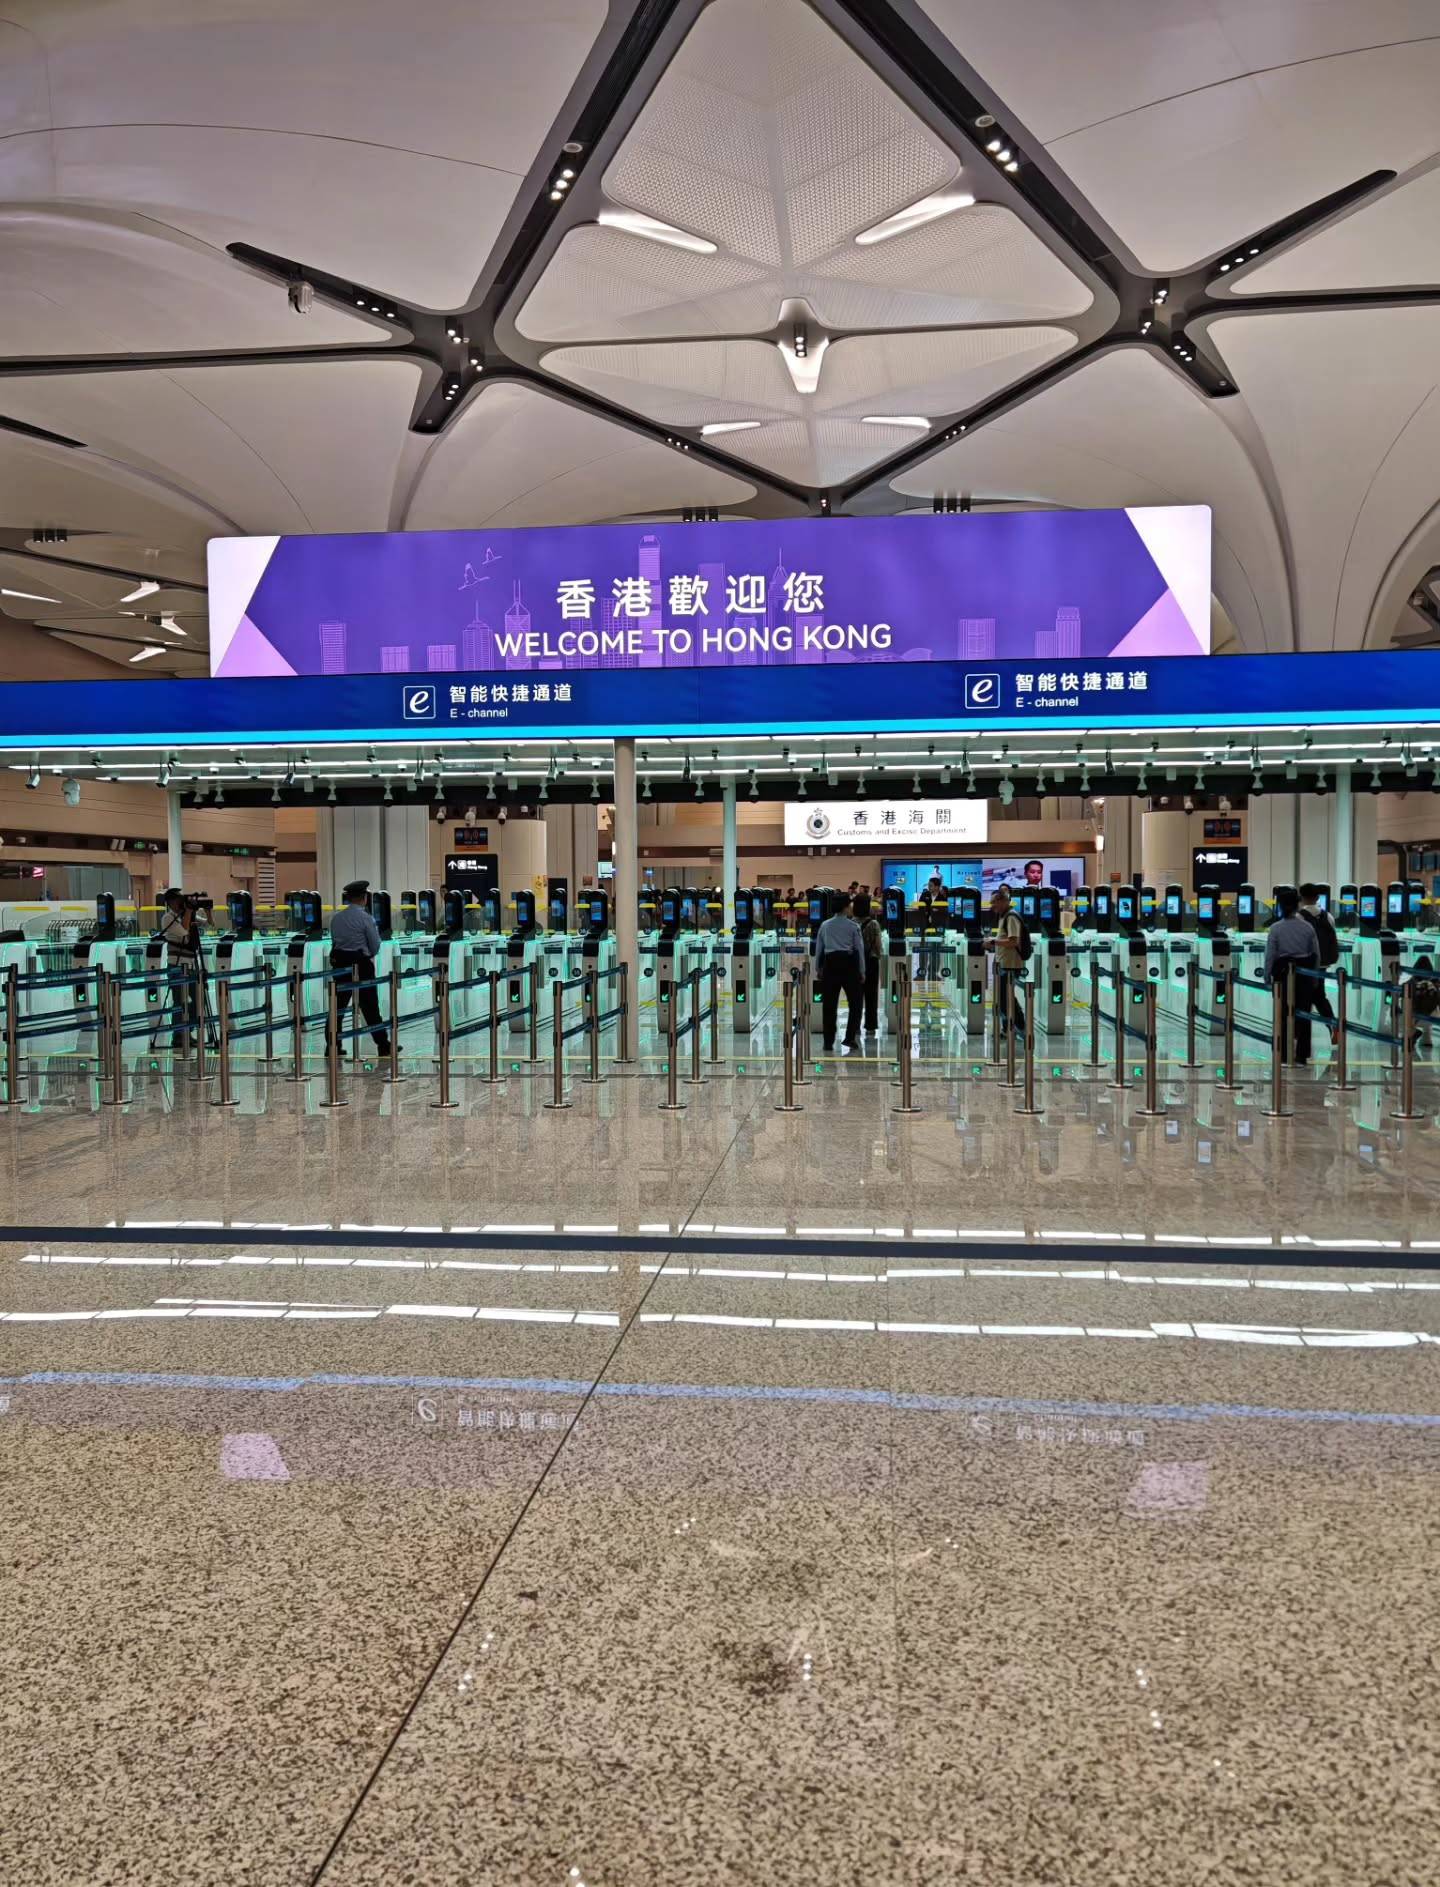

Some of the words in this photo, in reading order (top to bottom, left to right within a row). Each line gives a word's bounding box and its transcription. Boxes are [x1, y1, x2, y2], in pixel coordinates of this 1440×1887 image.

[556, 571, 825, 619] 香港歡迎您
[495, 629, 643, 657] WELCOME
[652, 628, 693, 654] TO
[702, 625, 793, 653] HONG
[803, 623, 892, 650] KONG
[1015, 671, 1148, 692] 智能快捷通道
[450, 683, 572, 703] 智能快捷通道
[1016, 697, 1024, 707] E
[1034, 696, 1079, 707] channel
[450, 708, 458, 718] E
[467, 707, 508, 718] channel
[853, 808, 952, 826] 香港海關
[837, 828, 872, 836] Customs
[920, 826, 967, 836] Department
